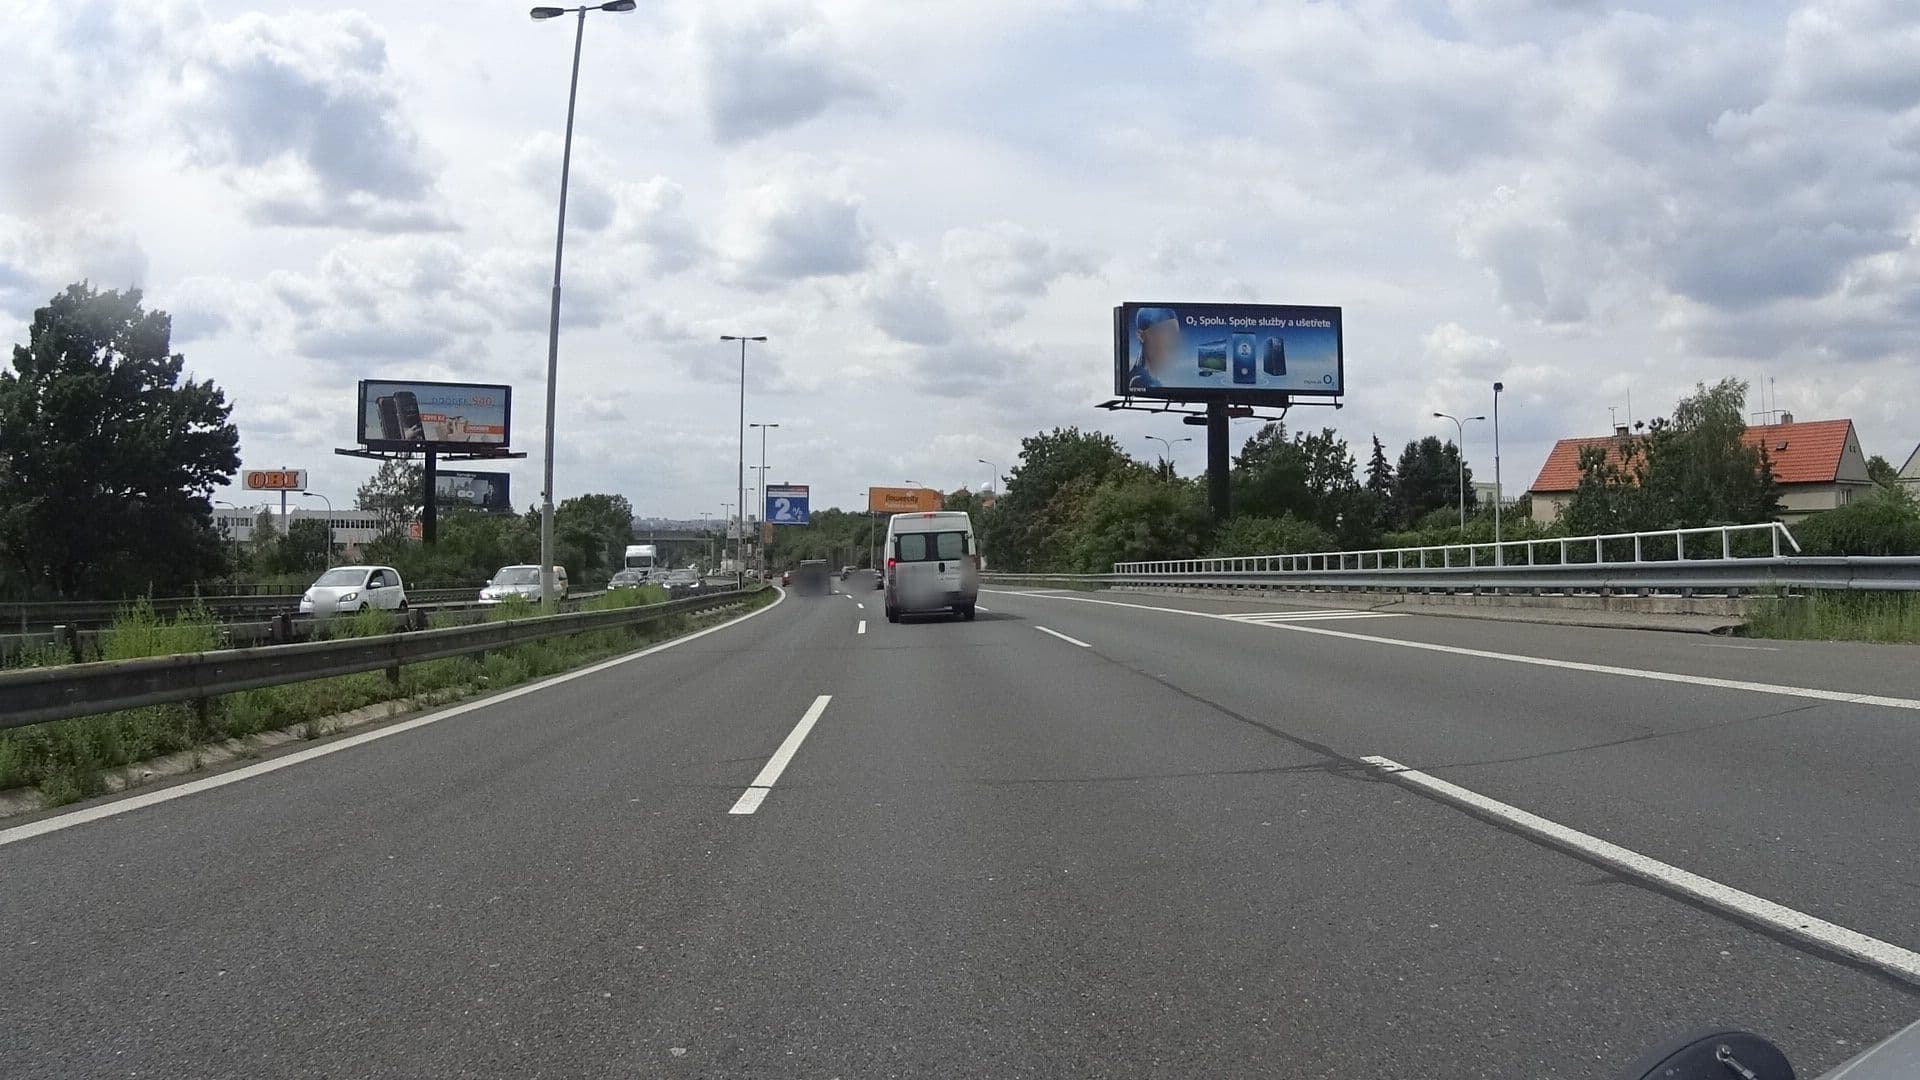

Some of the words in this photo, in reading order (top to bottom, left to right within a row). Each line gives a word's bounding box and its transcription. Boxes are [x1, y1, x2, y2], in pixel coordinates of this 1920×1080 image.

[1199, 316, 1227, 327] Spolu.
[1229, 316, 1256, 327] Spojte
[1258, 317, 1285, 328] služby
[1296, 318, 1331, 328] ušetřete
[248, 471, 298, 488] OBI
[457, 489, 476, 498] GO
[775, 498, 791, 519] 2
